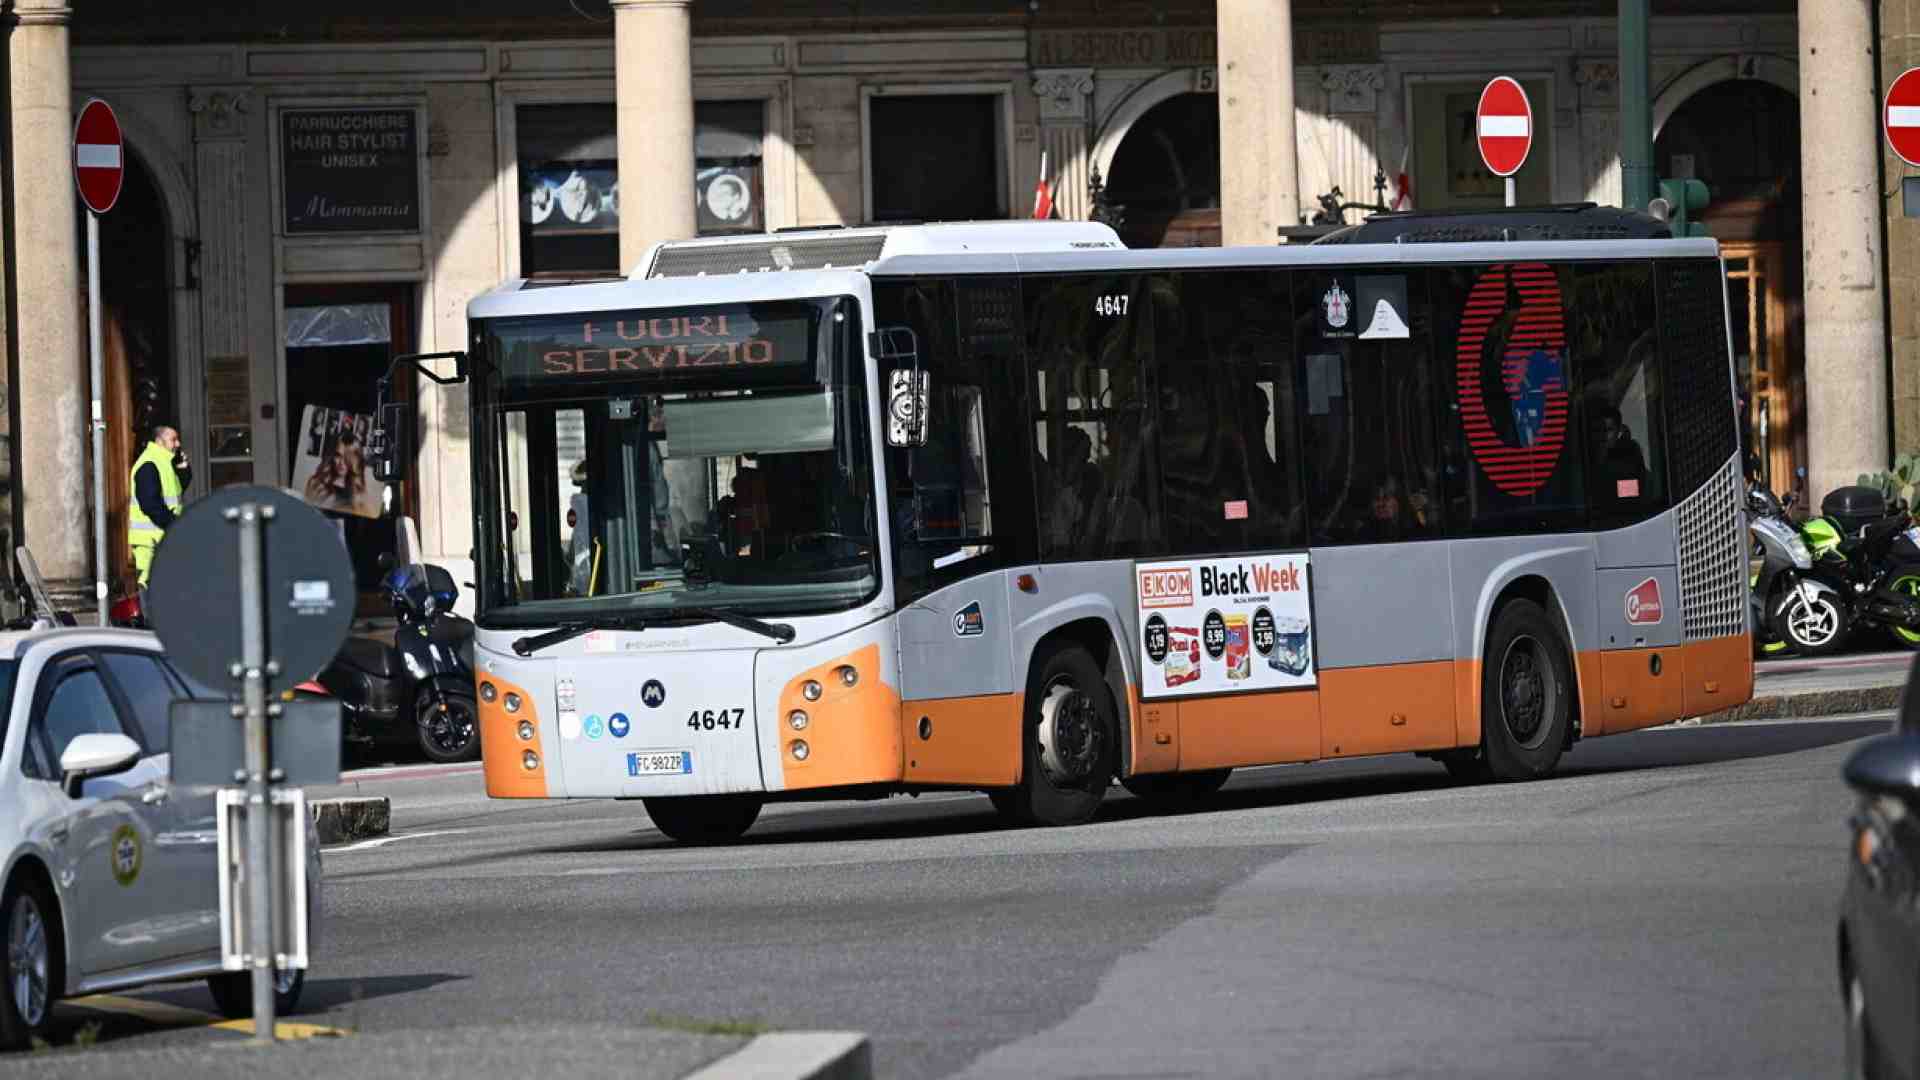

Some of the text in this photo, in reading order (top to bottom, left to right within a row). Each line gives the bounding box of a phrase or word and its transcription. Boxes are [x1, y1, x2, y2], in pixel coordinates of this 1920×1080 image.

[1037, 31, 1153, 64] ALBERGO
[1199, 70, 1212, 90] 5
[290, 114, 409, 130] PARRUCCHIERE
[290, 132, 408, 151] HAIR STYLIST
[320, 153, 378, 168] UNISEX
[1095, 294, 1129, 316] 4647
[583, 315, 729, 343] FUORI
[543, 337, 775, 374] SERVIZIO
[1143, 574, 1191, 595] EKOM
[1200, 561, 1300, 597] Black Week
[687, 707, 745, 731] 4647
